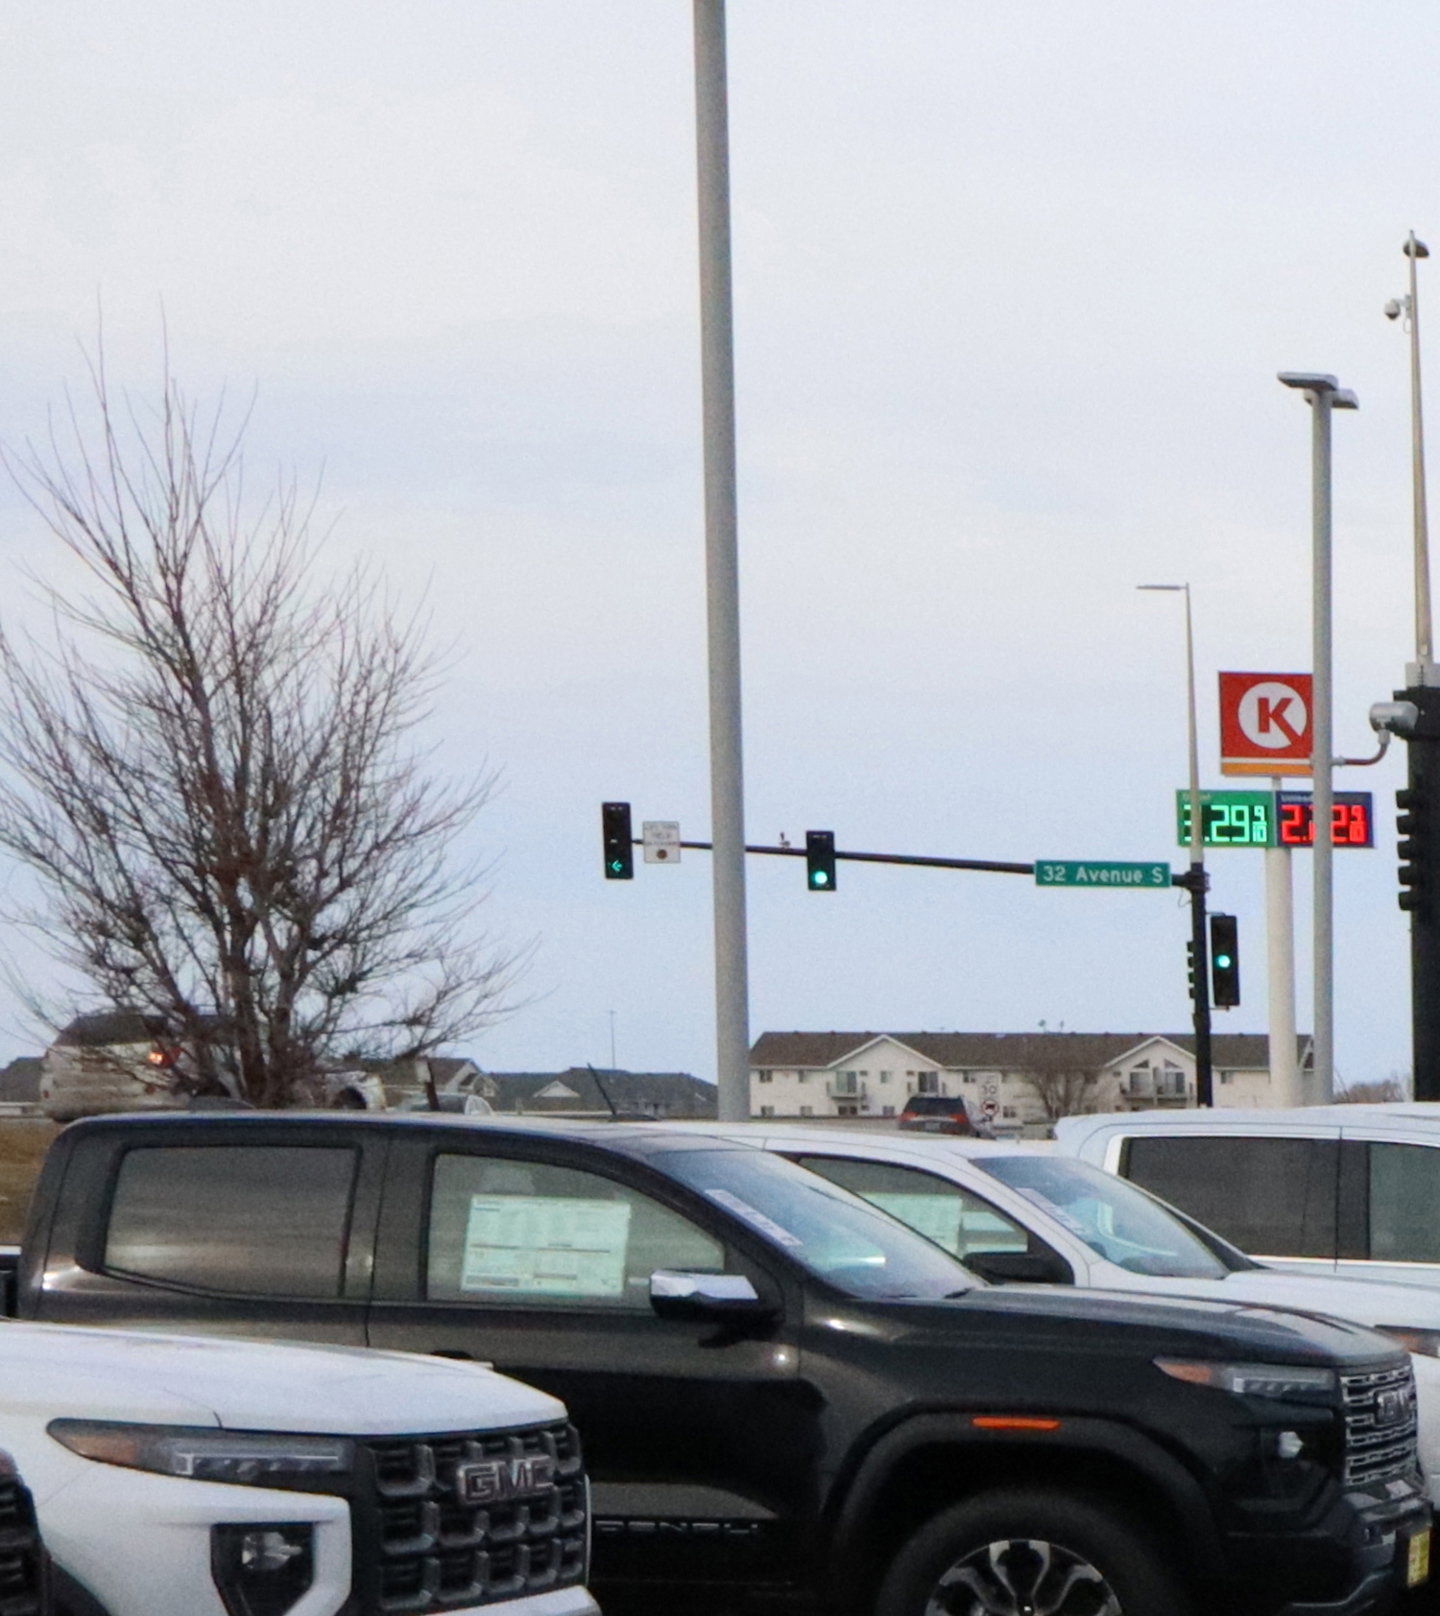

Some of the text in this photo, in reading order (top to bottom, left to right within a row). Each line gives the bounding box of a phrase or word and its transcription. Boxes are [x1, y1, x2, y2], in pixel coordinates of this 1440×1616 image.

[1257, 697, 1300, 745] K
[1281, 804, 1348, 843] 2.2
[1043, 865, 1164, 883] 32 Avenue S
[458, 1456, 553, 1504] GMC
